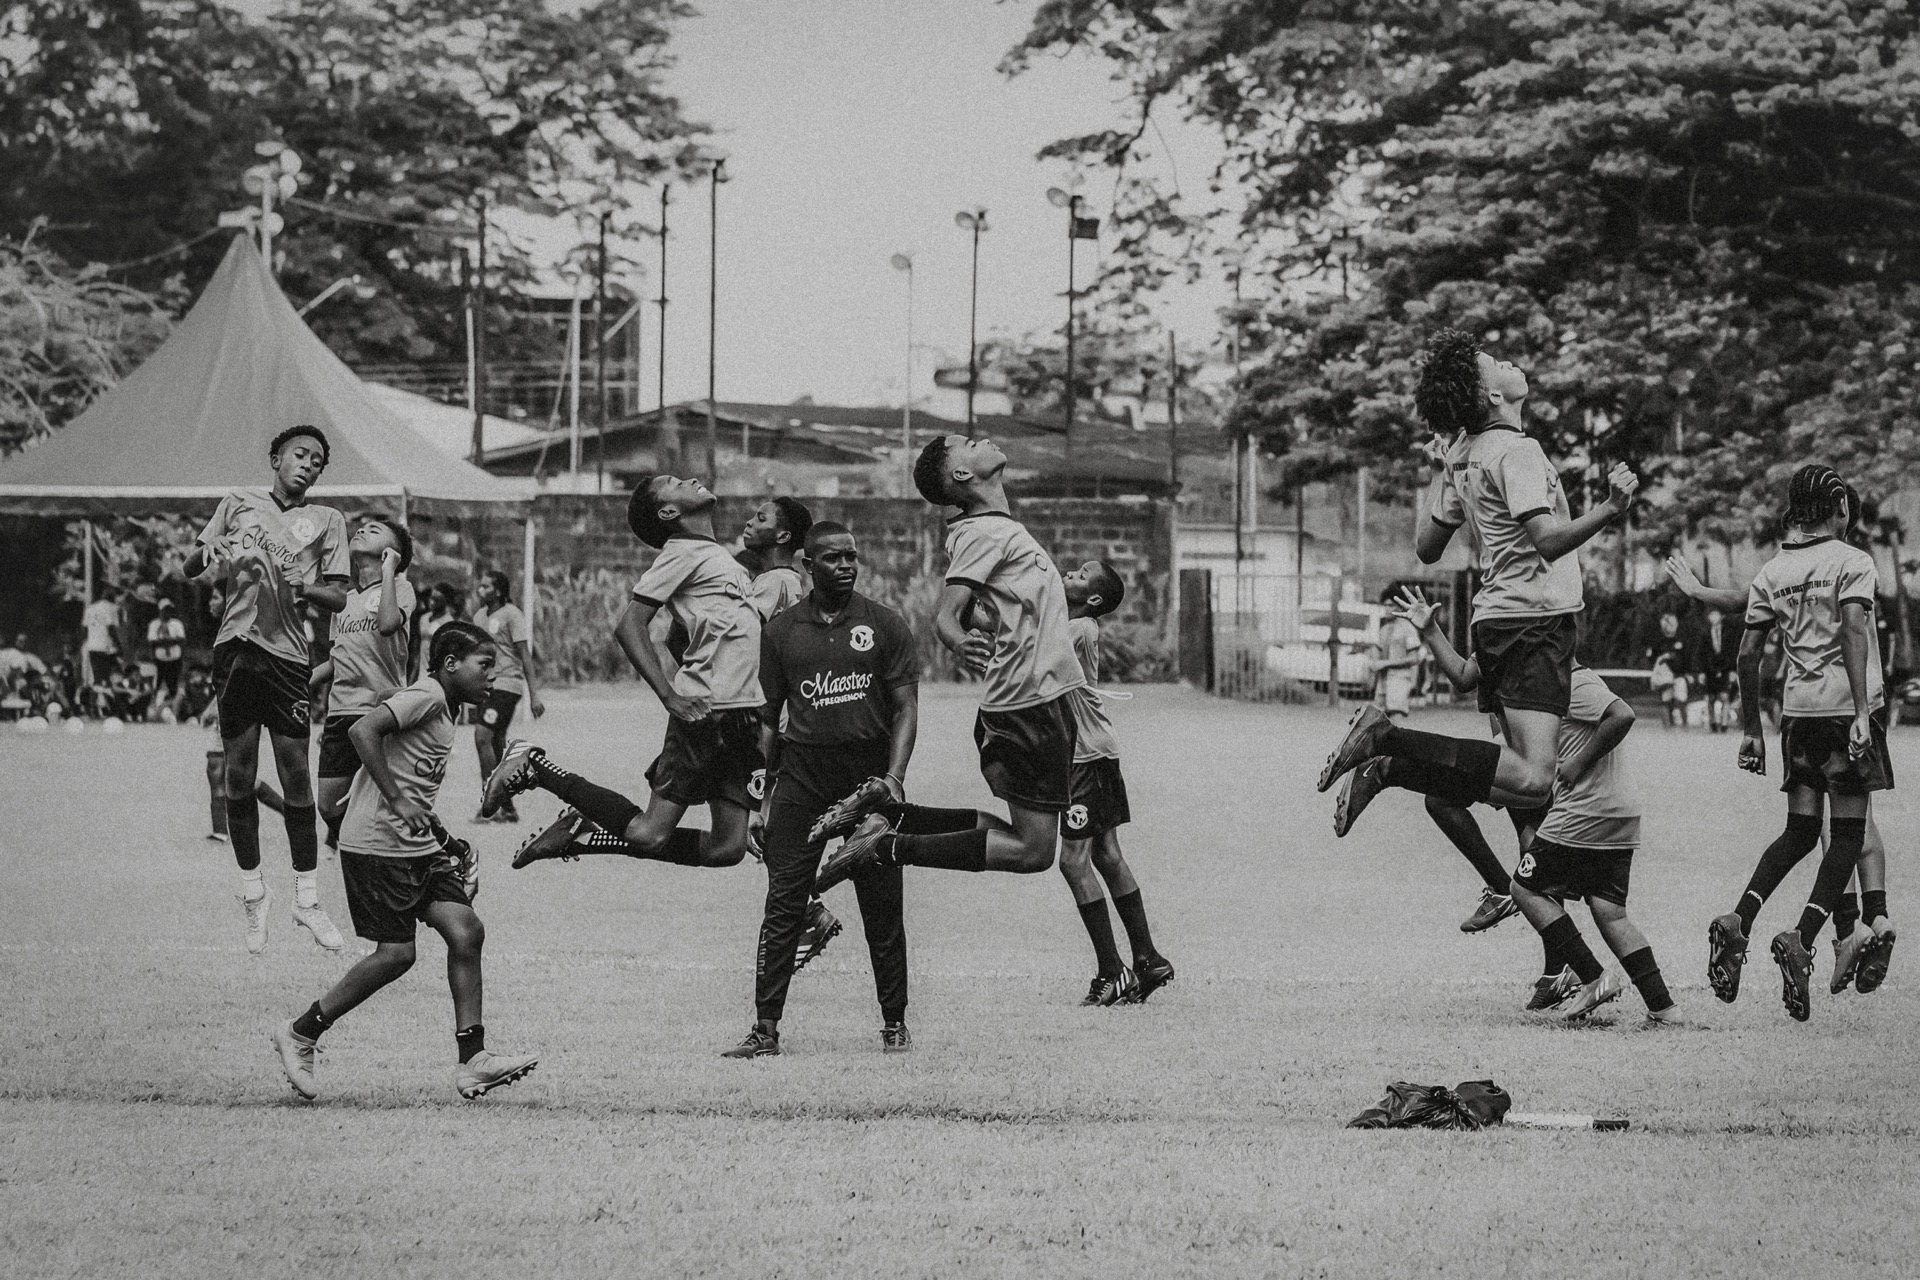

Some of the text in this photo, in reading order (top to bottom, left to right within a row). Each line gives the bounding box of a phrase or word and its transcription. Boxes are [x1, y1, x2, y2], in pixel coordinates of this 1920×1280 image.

[242, 524, 298, 563] Maestros
[800, 670, 873, 699] Maestros
[819, 692, 863, 707] FREQUENCY
